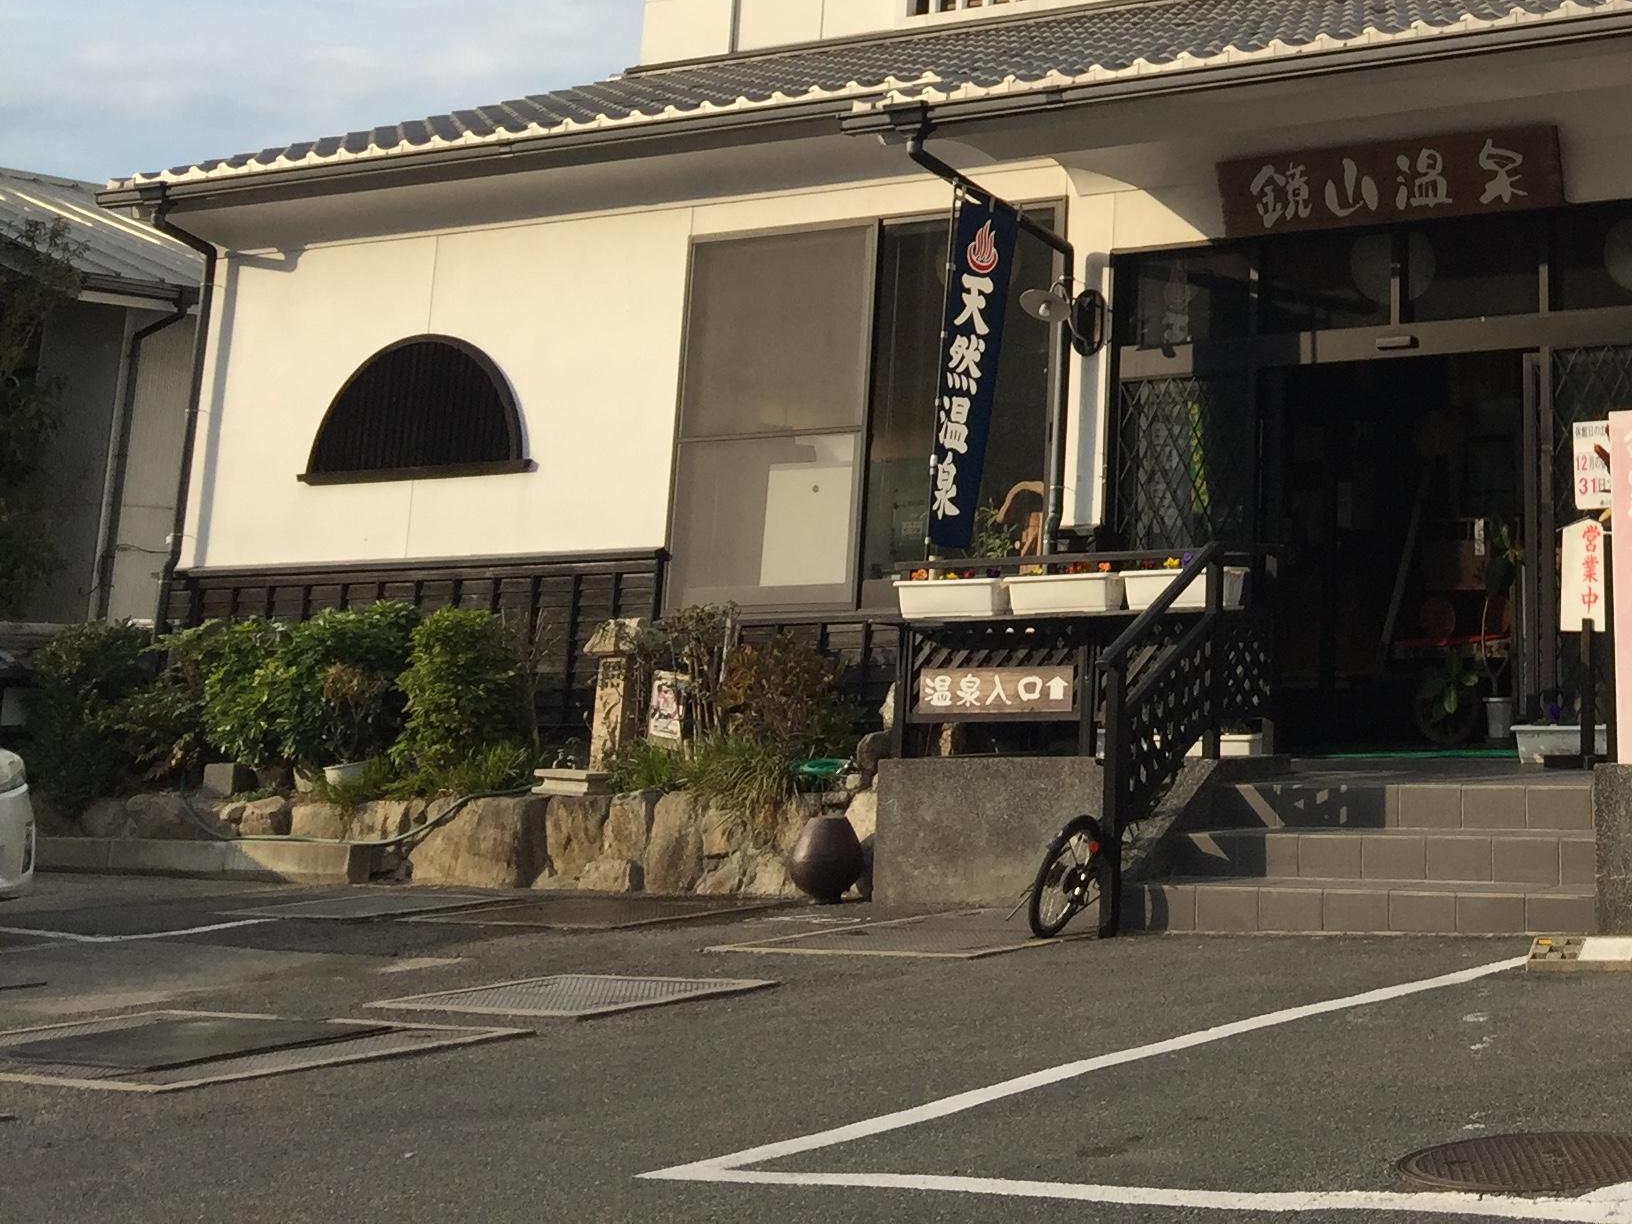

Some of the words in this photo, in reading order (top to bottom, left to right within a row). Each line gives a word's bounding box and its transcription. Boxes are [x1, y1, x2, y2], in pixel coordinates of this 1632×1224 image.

[1250, 138, 1529, 228] 鏡山温泉
[931, 272, 996, 520] 天然温泉
[1581, 525, 1600, 613] 営業中
[924, 673, 1043, 707] 温泉入口
